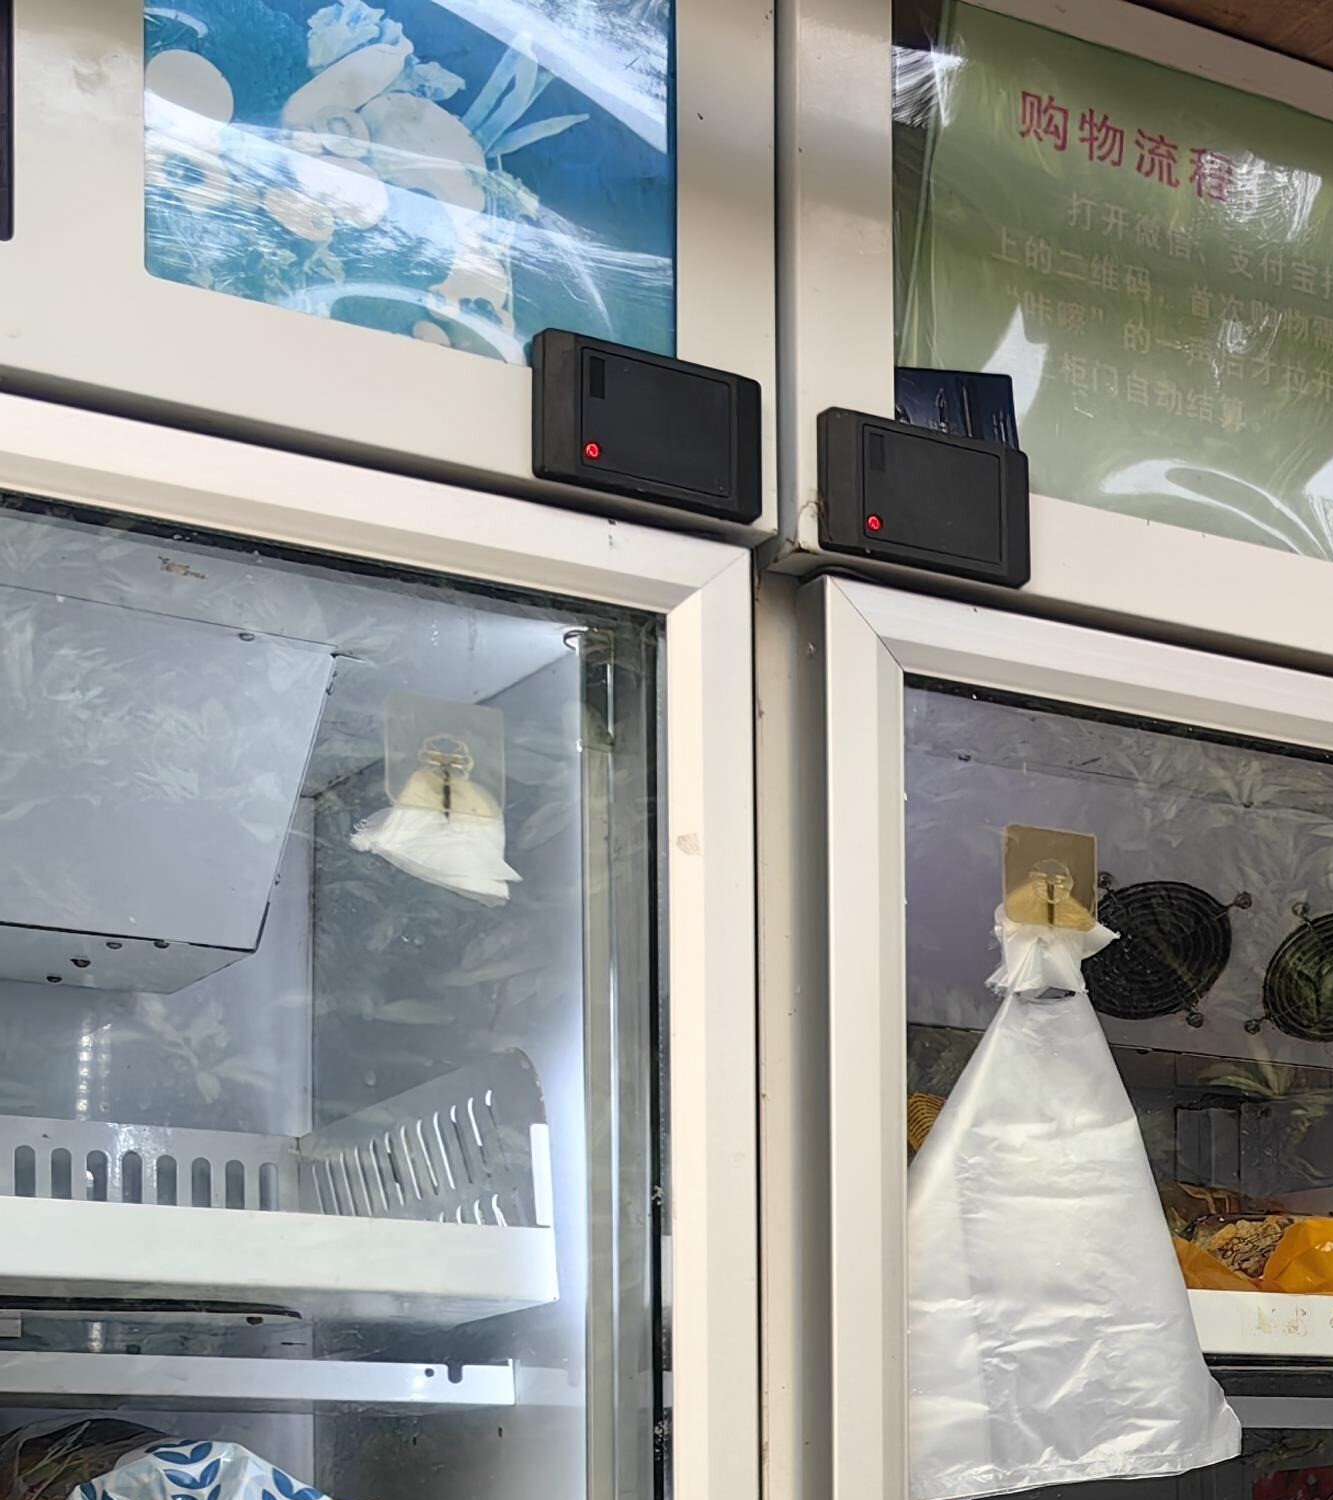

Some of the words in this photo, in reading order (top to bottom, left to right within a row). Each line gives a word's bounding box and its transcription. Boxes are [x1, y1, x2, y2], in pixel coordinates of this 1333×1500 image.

[1044, 350, 1262, 434] 柜门自动结算。
